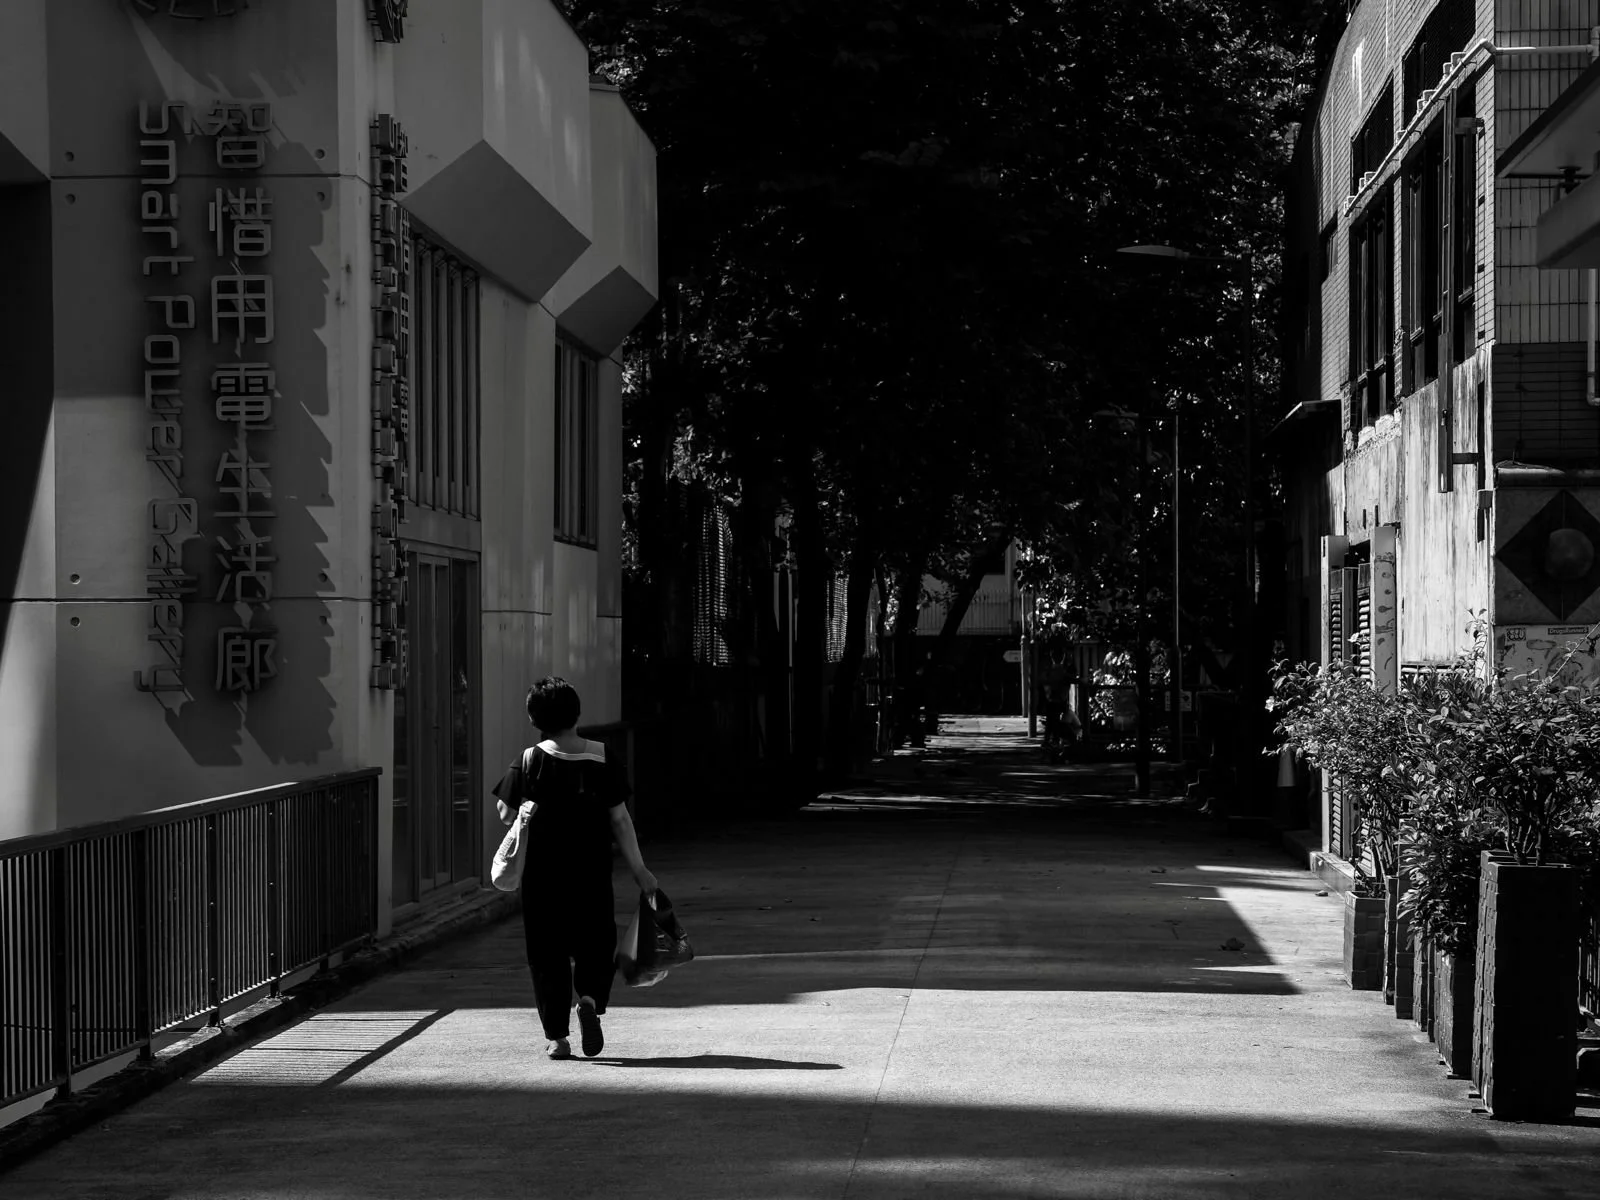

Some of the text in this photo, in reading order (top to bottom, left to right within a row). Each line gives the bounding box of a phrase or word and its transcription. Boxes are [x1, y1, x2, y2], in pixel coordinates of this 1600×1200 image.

[134, 100, 200, 692] Smart Power Gallery
[208, 101, 278, 692] 智惜用電生活廊
